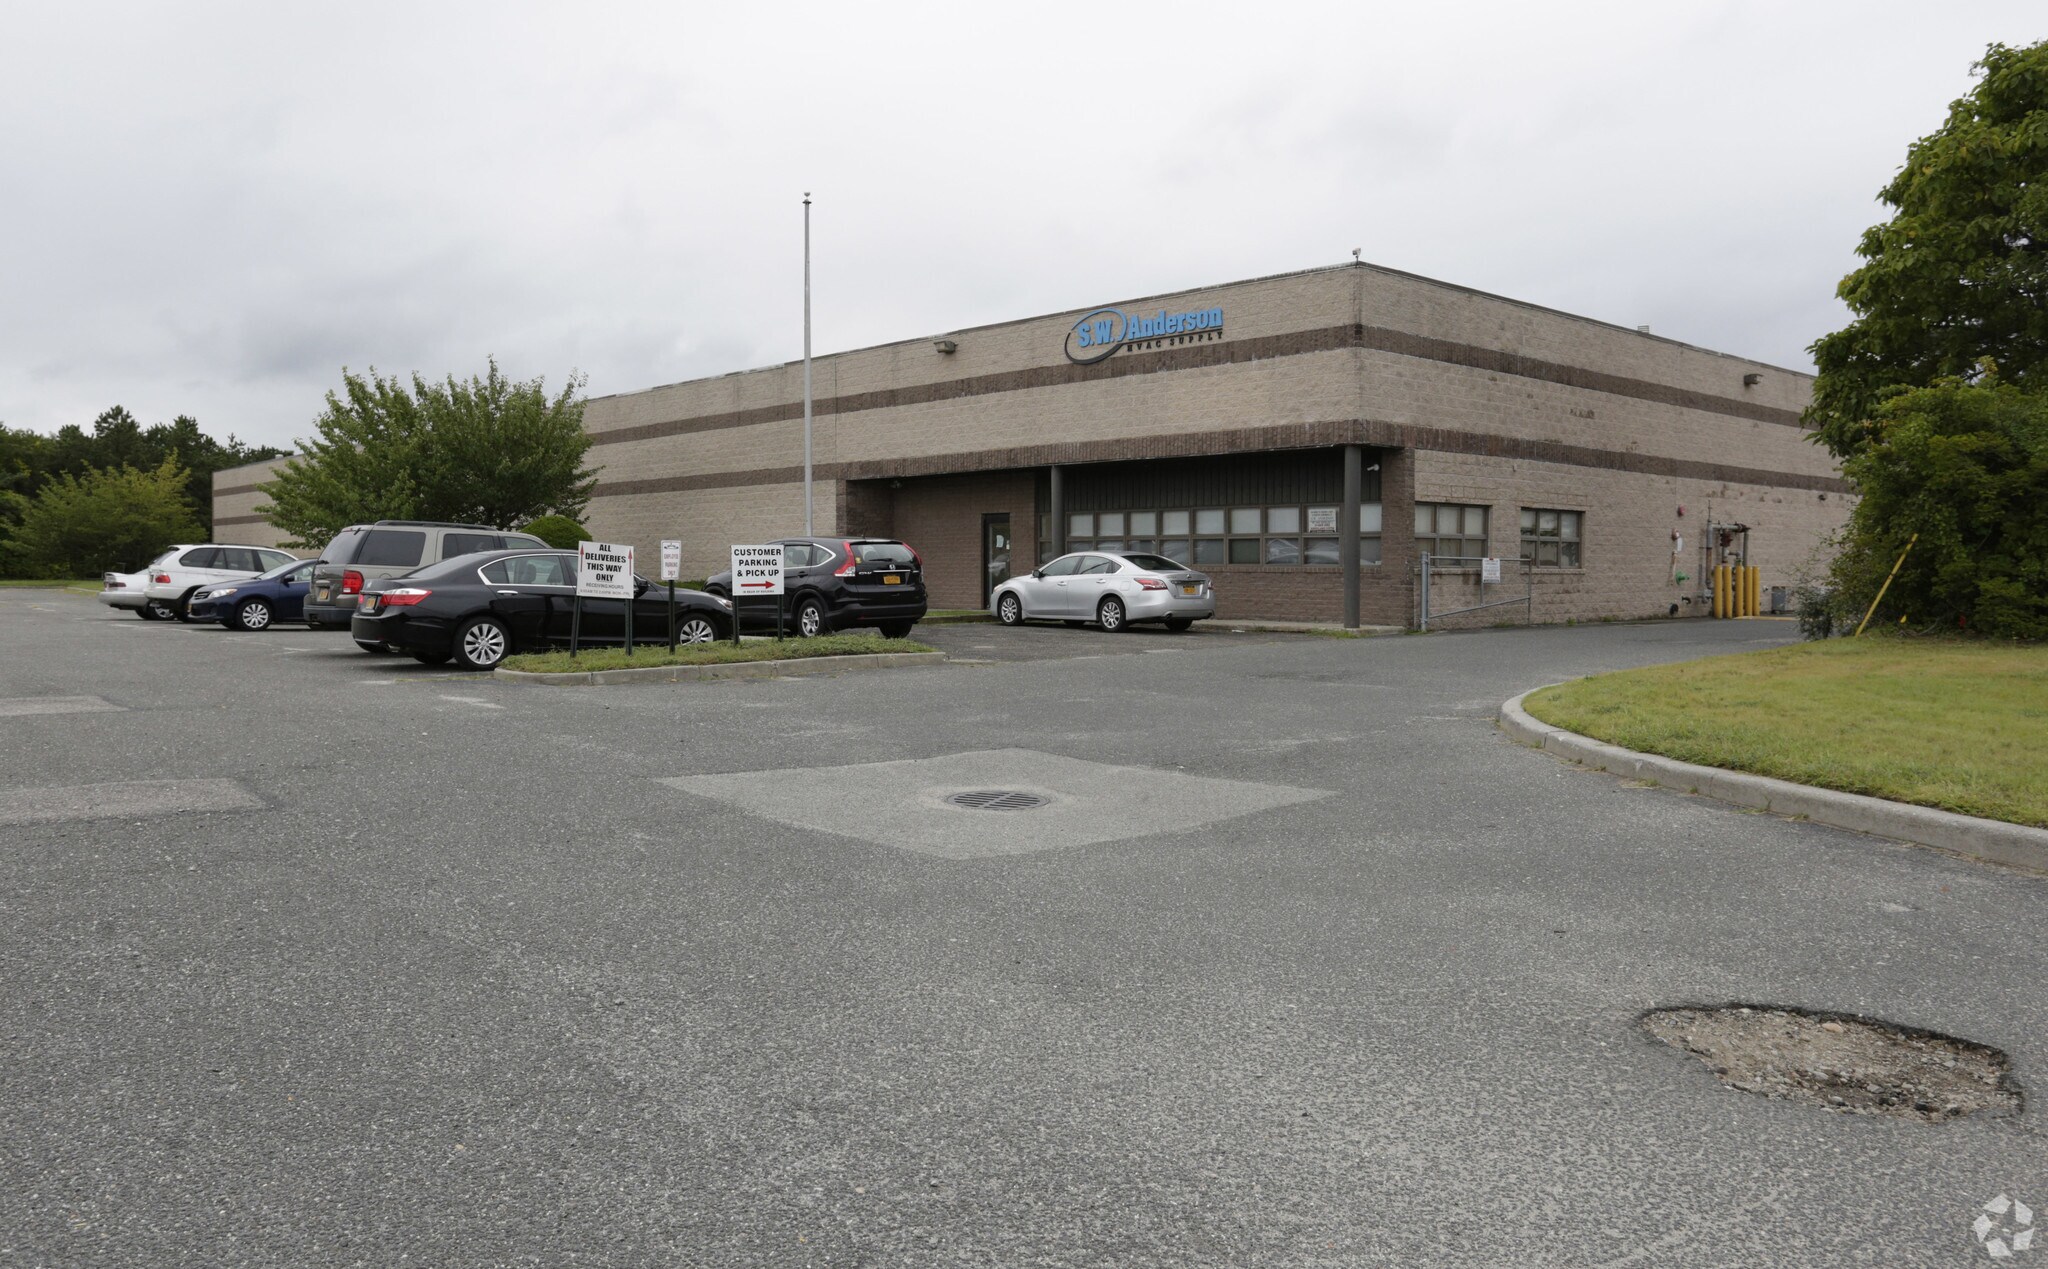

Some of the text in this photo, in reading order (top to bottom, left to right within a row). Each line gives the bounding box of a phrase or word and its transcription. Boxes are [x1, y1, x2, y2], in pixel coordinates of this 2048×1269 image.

[1077, 307, 1224, 348] S.W. Anderson
[1127, 331, 1223, 352] HVAC SUPPLY
[599, 544, 611, 552] ALL
[733, 548, 782, 556] CUSTOMER
[585, 552, 627, 563] DELIVERIES
[587, 562, 622, 572] THIS WAY
[595, 573, 614, 582] ONLY
[736, 569, 780, 577] & PICK UP
